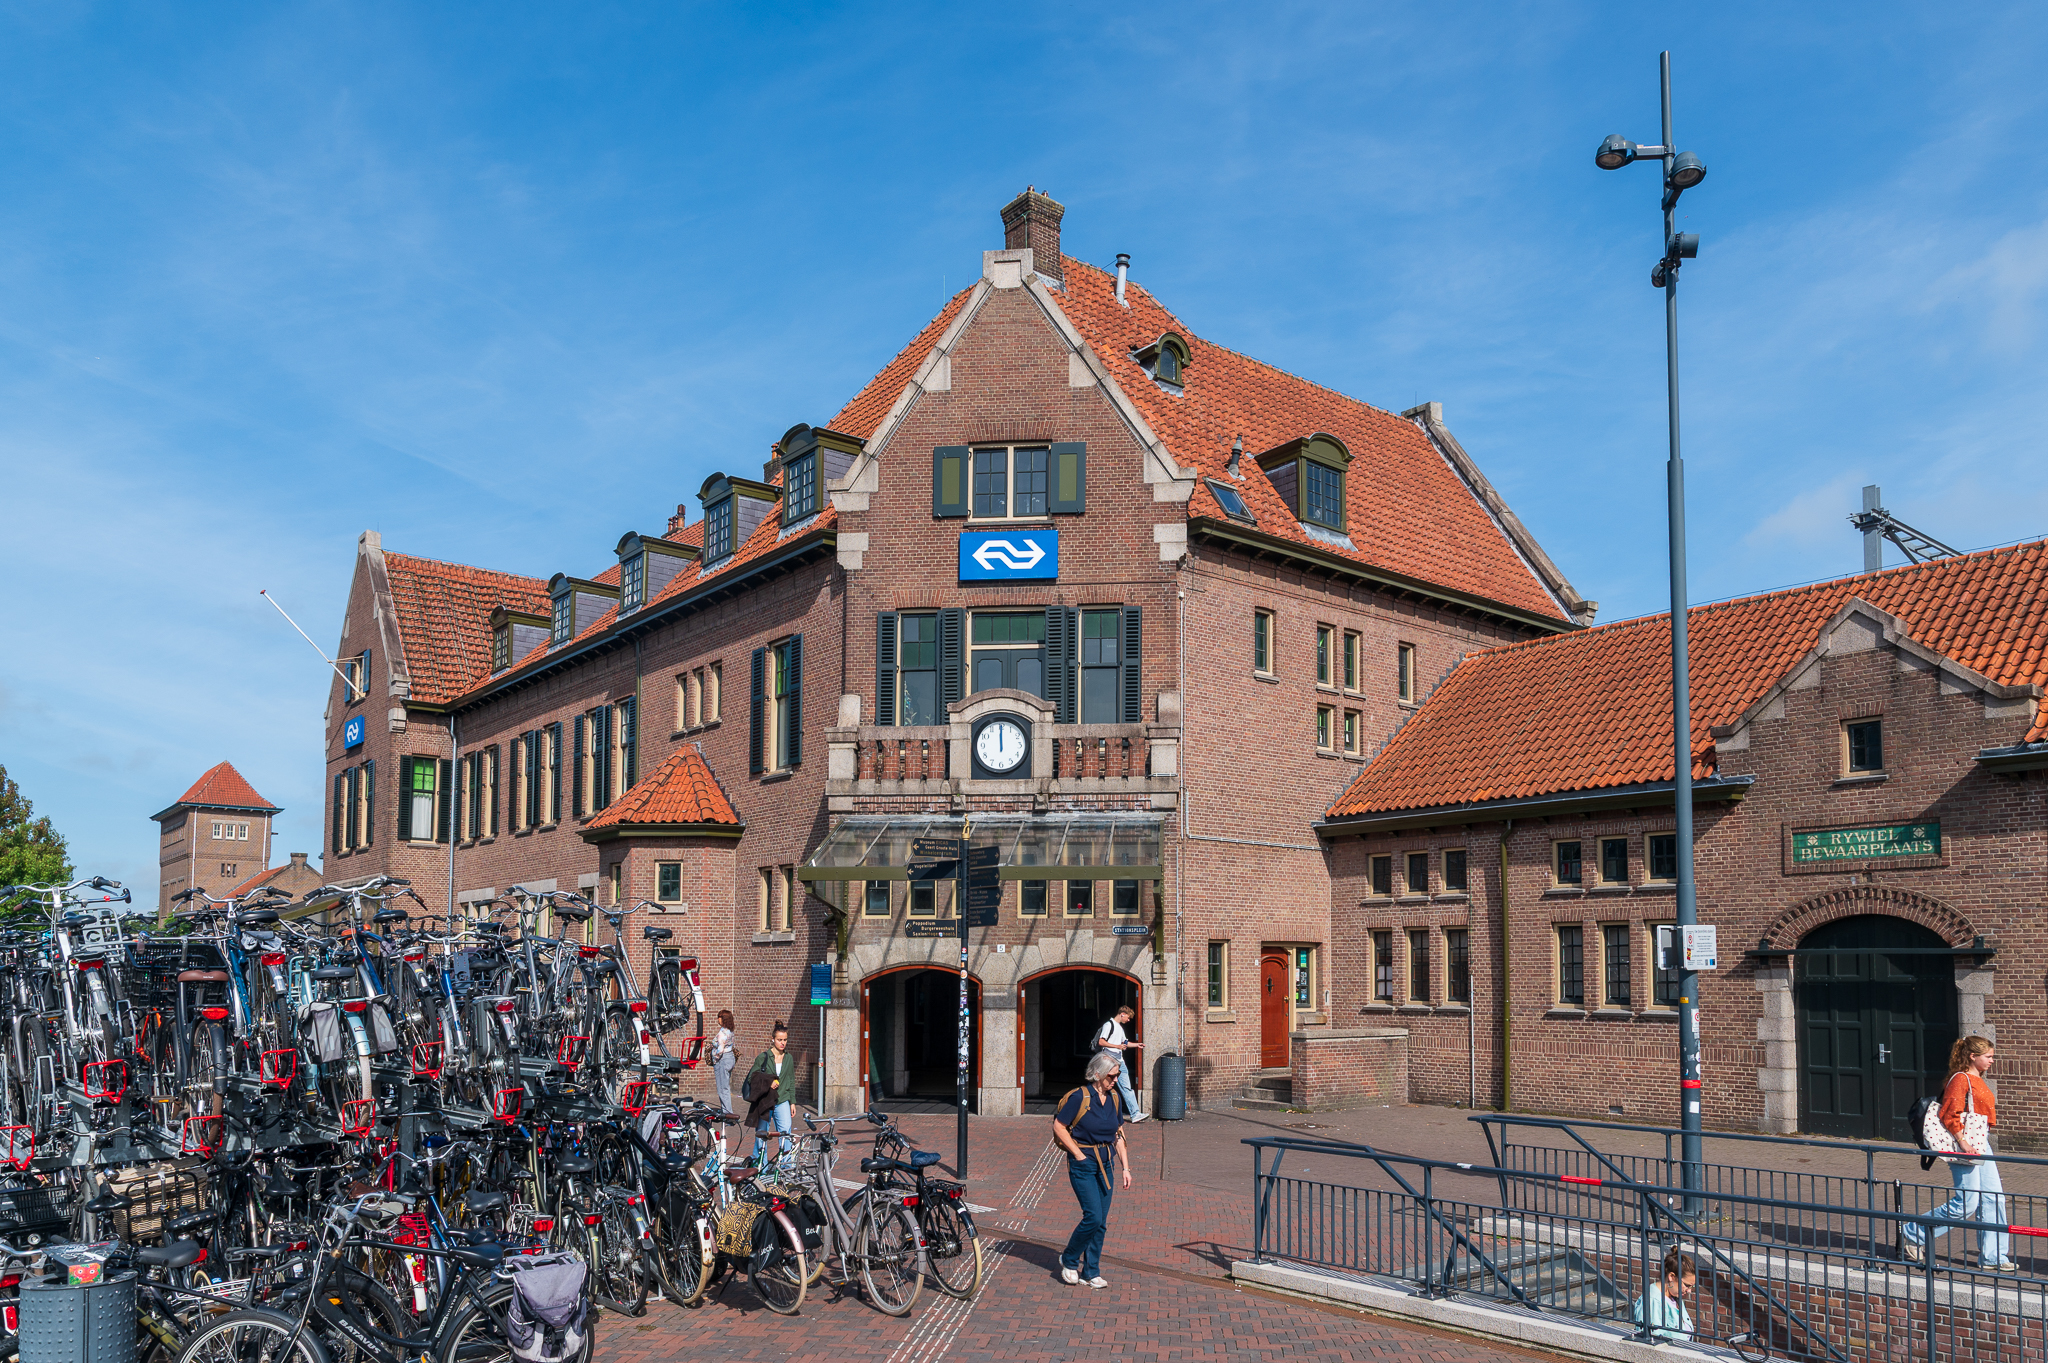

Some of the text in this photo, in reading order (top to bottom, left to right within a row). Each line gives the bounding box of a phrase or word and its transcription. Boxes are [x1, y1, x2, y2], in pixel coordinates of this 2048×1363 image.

[1831, 830, 1899, 844] RYWIEL
[1801, 840, 1933, 859] BEWAARPLAATS
[338, 1319, 381, 1354] BATAVUS
